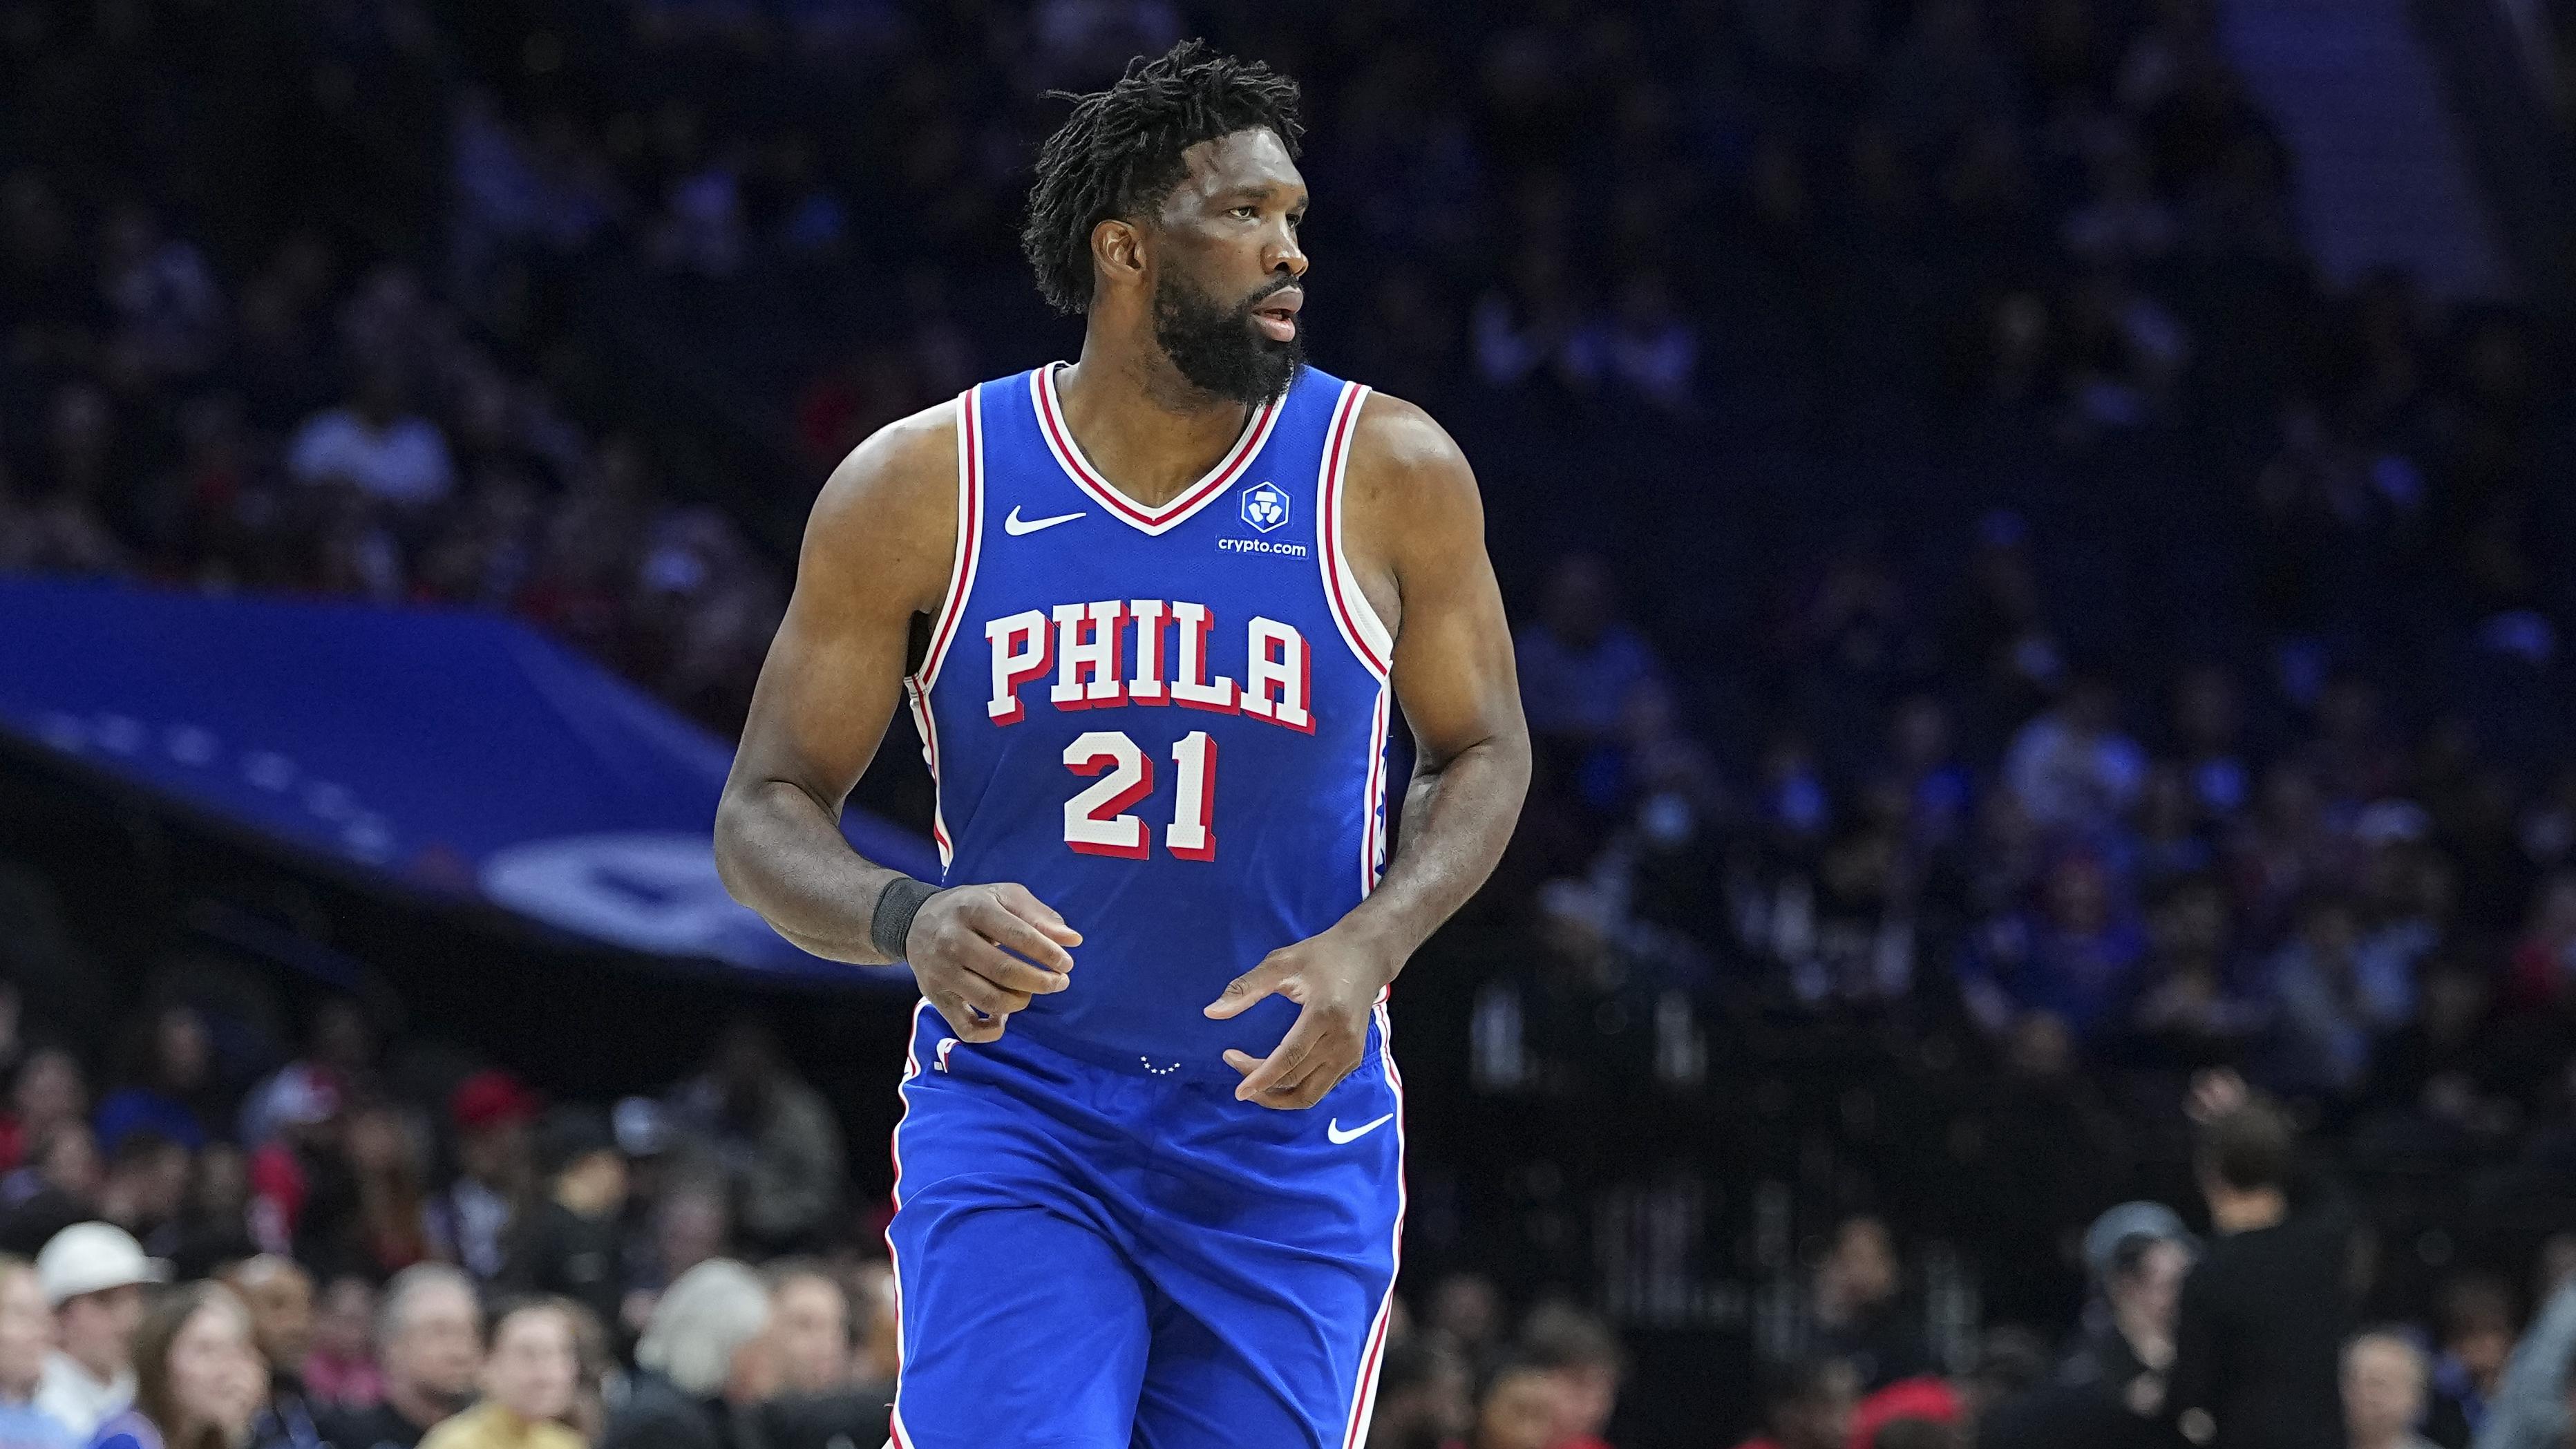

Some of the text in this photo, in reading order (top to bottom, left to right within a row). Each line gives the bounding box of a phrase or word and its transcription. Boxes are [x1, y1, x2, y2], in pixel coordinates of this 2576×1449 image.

[1218, 538, 1306, 556] crypto.com
[985, 599, 1315, 735] PHILA
[1063, 731, 1217, 861] 21
